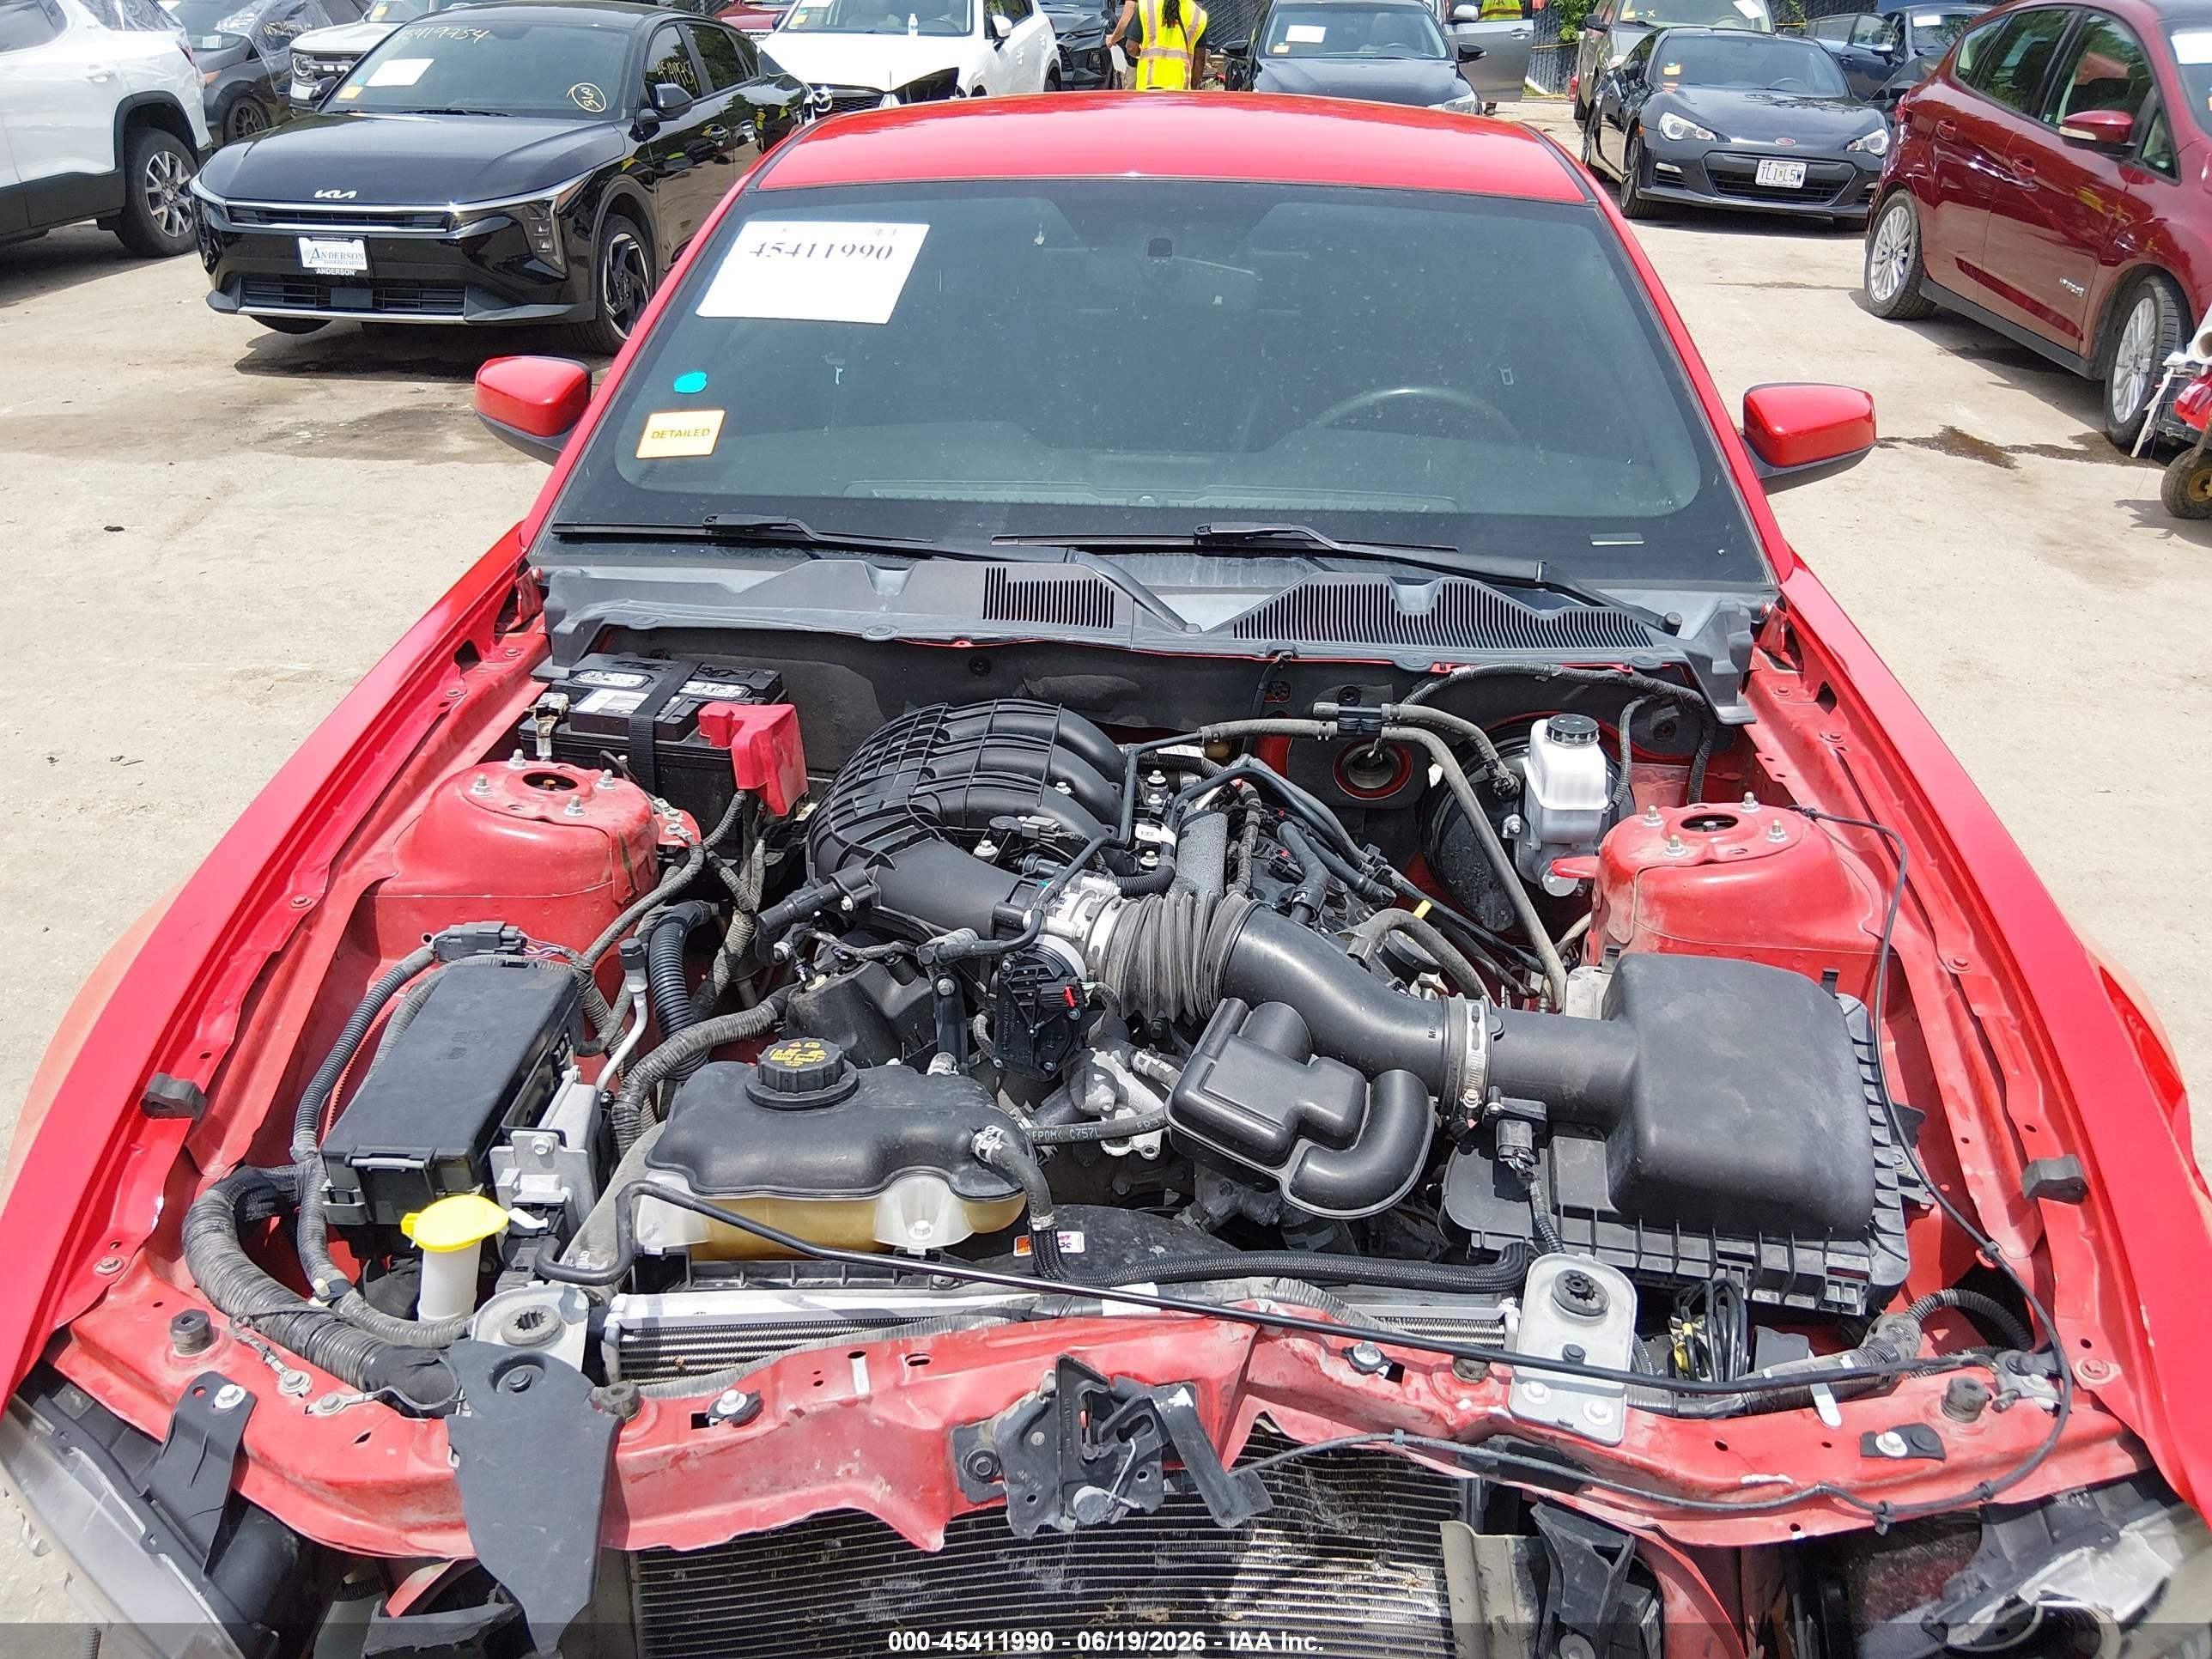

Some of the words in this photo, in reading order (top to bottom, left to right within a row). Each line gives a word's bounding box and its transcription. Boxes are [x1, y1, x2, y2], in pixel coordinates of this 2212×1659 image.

[308, 247, 364, 264] ANDERSON
[750, 242, 893, 260] 45411990
[651, 428, 710, 439] DETAILED
